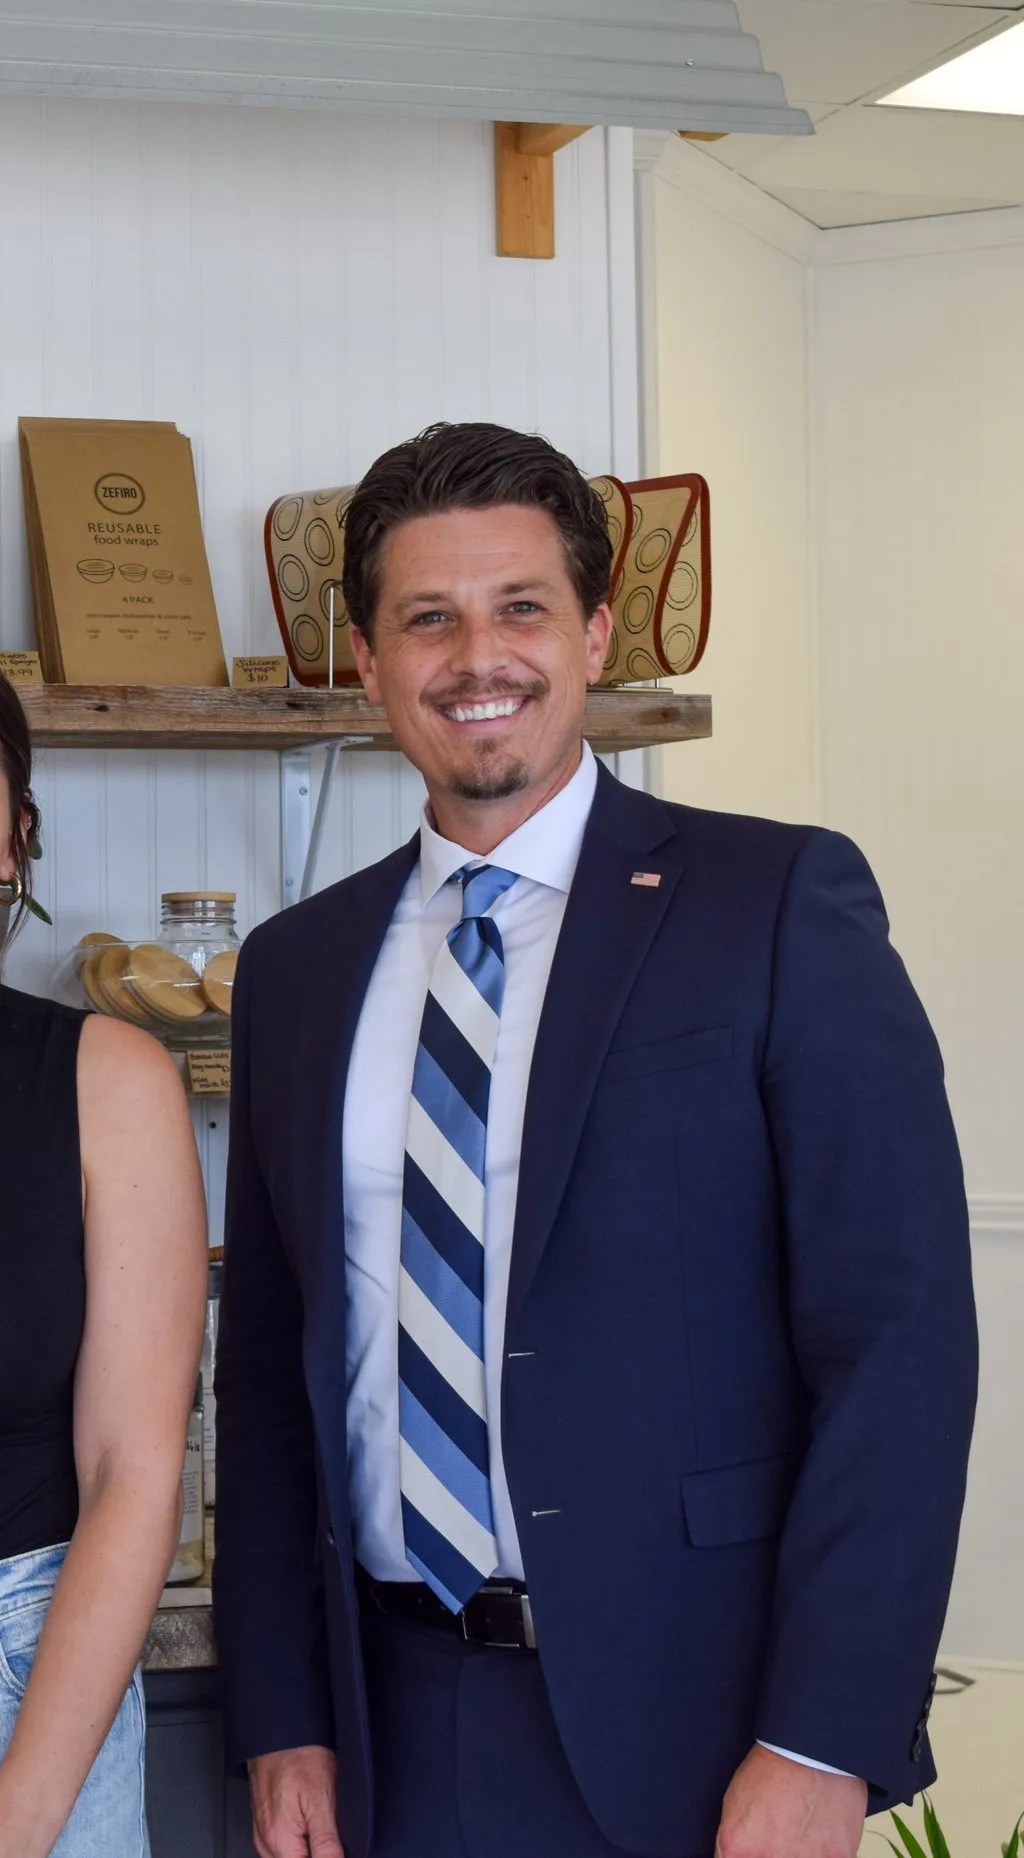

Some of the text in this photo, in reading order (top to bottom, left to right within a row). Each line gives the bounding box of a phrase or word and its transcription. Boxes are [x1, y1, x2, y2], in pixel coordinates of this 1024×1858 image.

[102, 487, 137, 499] ZEFIRO
[88, 522, 161, 534] REUSABLE
[94, 534, 159, 547] food wraps
[129, 596, 154, 604] PACK
